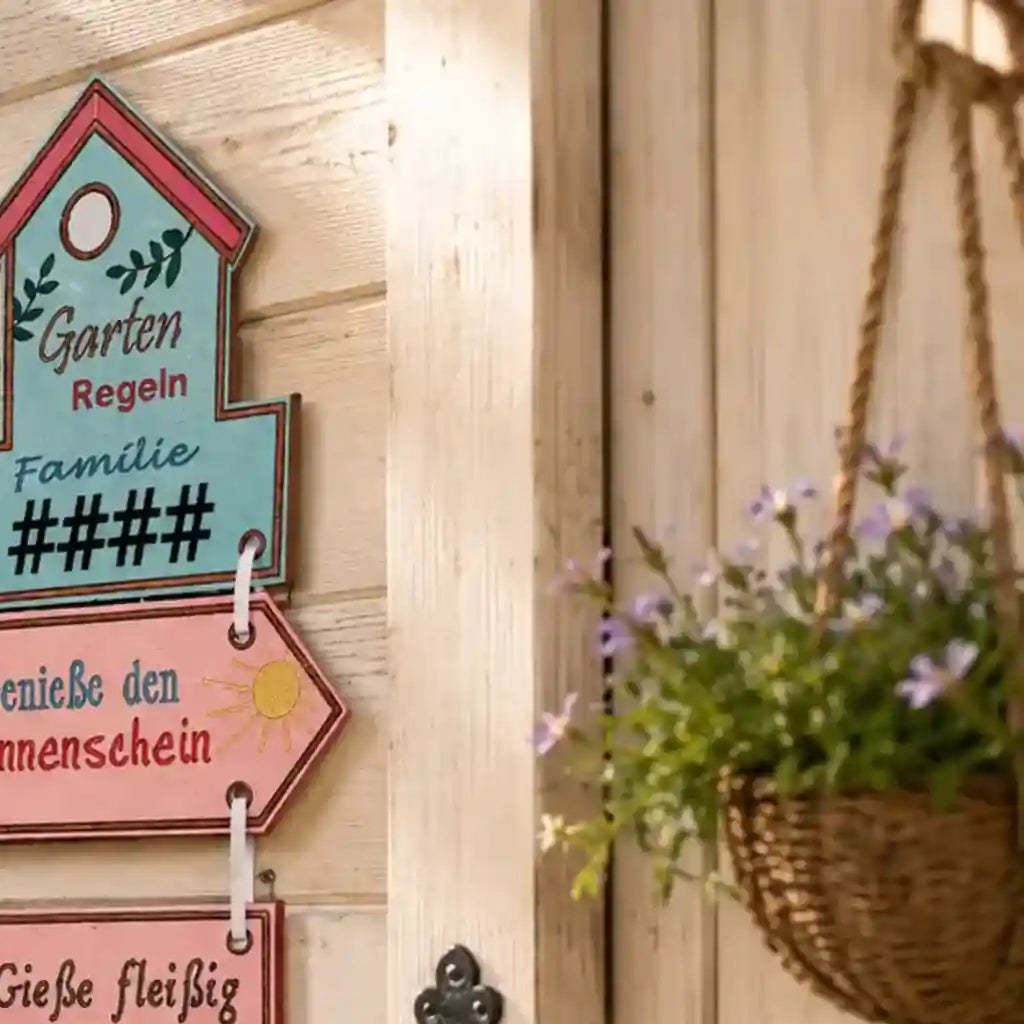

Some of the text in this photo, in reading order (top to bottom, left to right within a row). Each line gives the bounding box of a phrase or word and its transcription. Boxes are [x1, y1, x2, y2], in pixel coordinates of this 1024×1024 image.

[38, 297, 182, 375] Garten
[72, 368, 188, 413] Regeln
[14, 436, 200, 493] Familie
[123, 659, 180, 705] den
